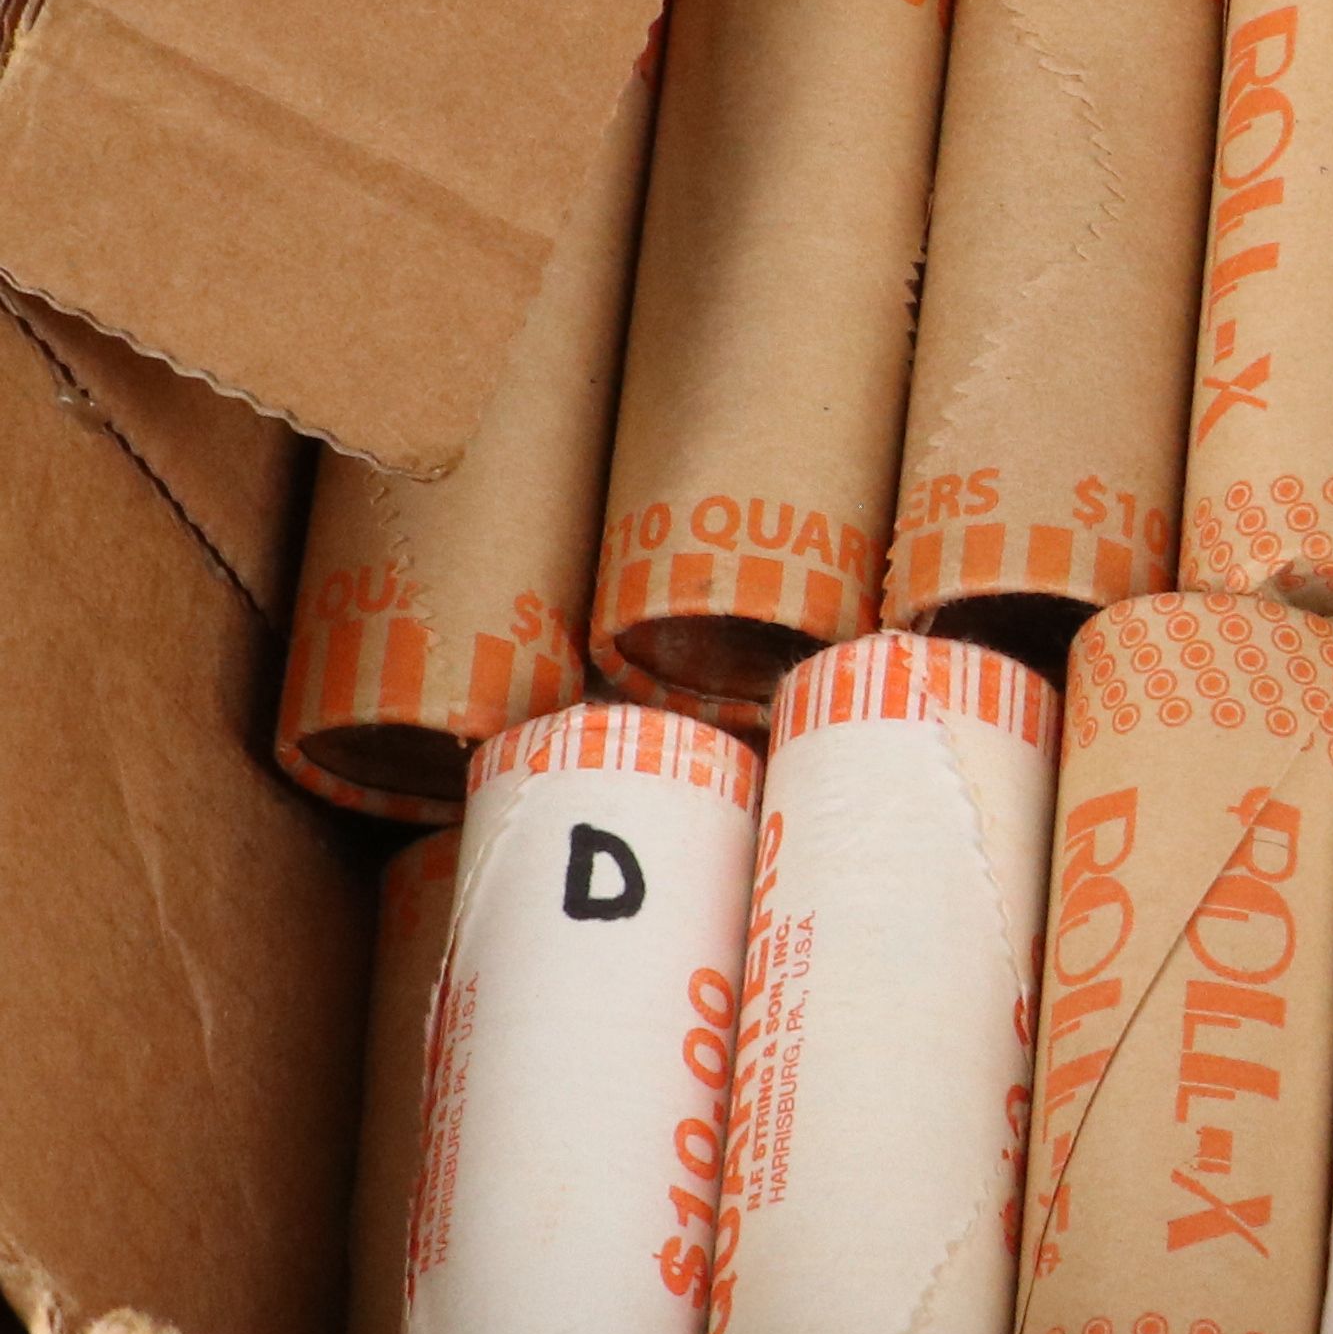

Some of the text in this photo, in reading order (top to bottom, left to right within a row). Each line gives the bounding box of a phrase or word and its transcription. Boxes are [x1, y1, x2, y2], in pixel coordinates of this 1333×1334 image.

[1197, 4, 1299, 448] ROLL-X
[689, 494, 876, 587] QUAR
[1072, 474, 1171, 557] $10
[510, 588, 580, 657] $1
[562, 822, 647, 922] D
[772, 914, 793, 968] INC.
[765, 972, 789, 1037] SON,
[1040, 786, 1139, 1217] ROLL-
[1166, 798, 1302, 1260] ROLL-X
[768, 1037, 805, 1205] HARRISBURG,
[791, 908, 817, 979] U.S.A.
[651, 965, 737, 1312] $10.00
[752, 1064, 775, 1162] STRING
